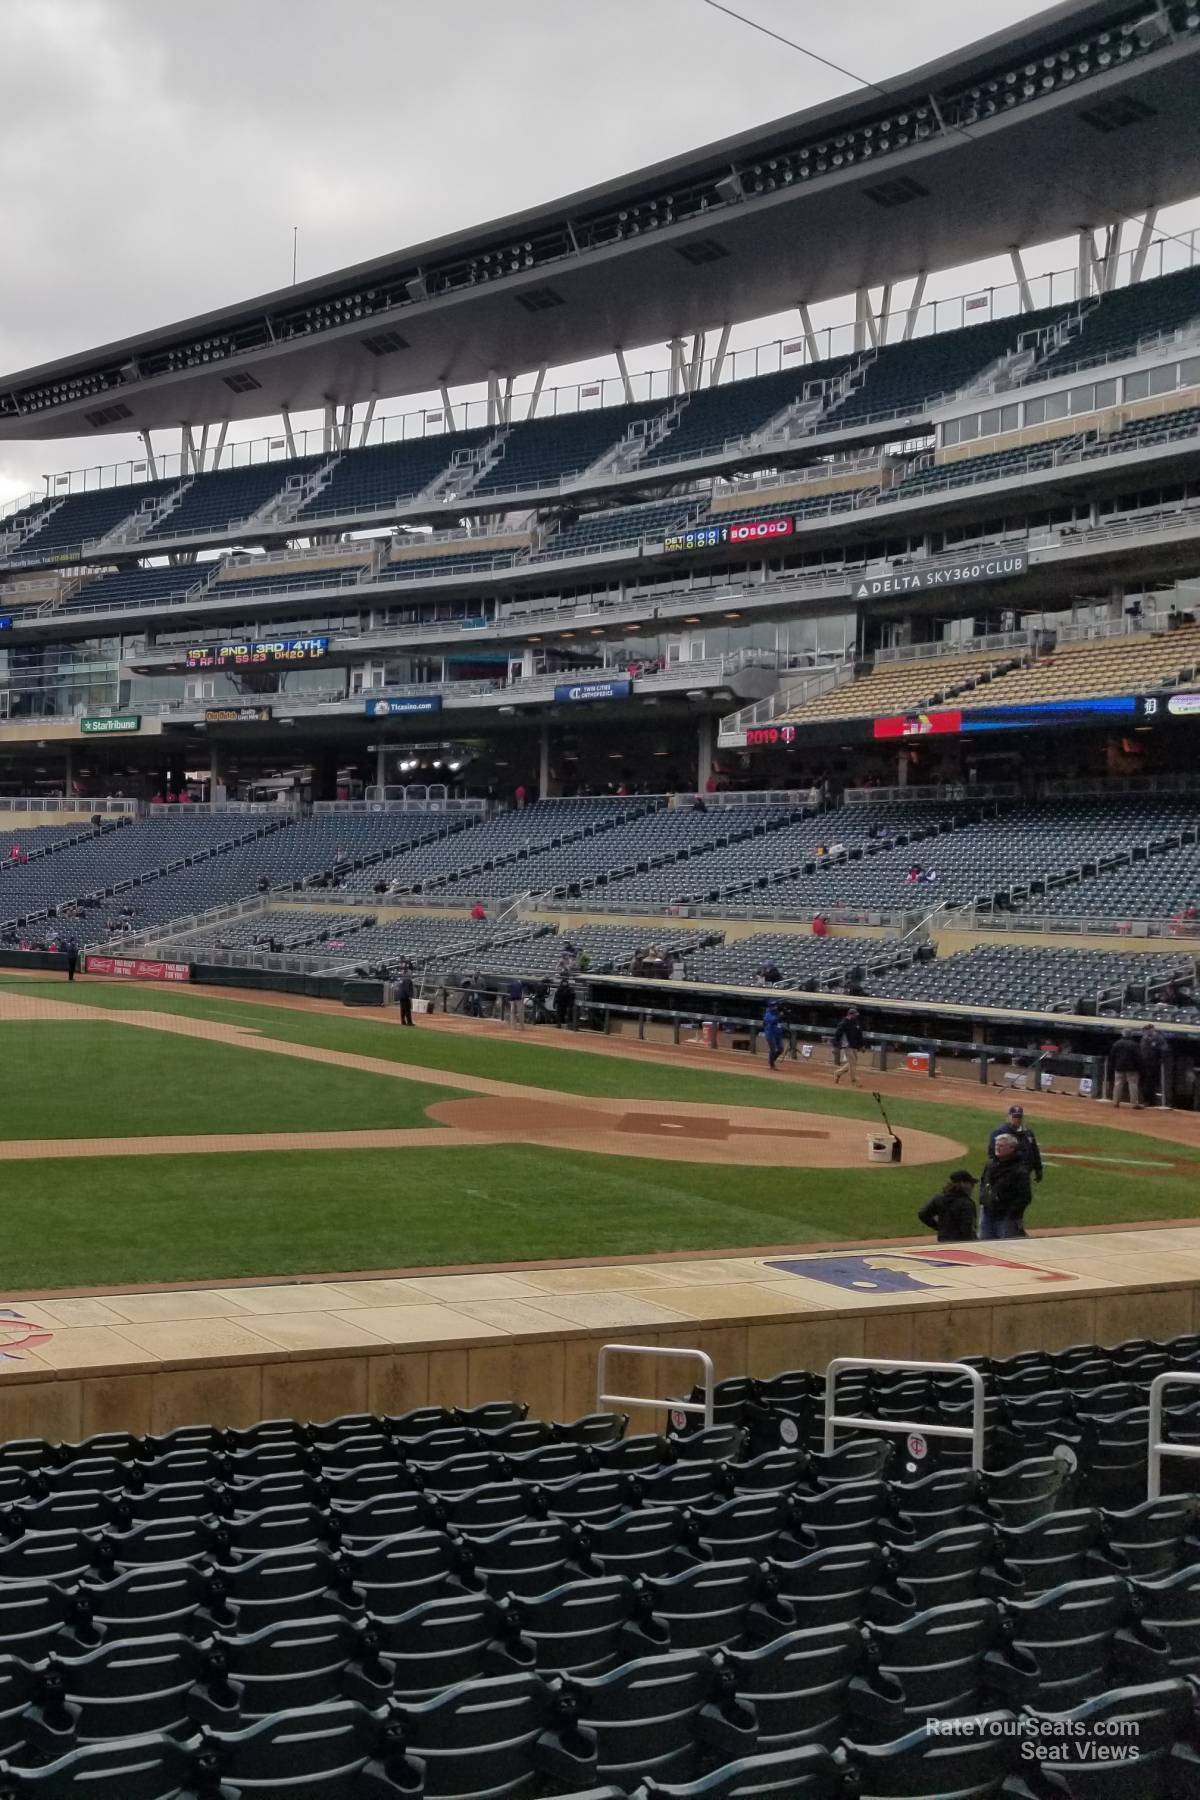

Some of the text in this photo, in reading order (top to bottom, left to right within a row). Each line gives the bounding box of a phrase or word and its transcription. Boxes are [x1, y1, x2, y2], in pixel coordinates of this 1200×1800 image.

[665, 536, 683, 545] DET
[665, 544, 682, 552] MIN
[872, 576, 921, 594] DELTA
[188, 640, 320, 658] 1ST 2ND 3RD 4TH
[253, 653, 266, 662] 23
[275, 651, 289, 660] DH
[290, 650, 304, 659] 20
[310, 649, 323, 657] LF
[581, 690, 613, 698] ORTHOPEDICS
[92, 720, 136, 730] StarTribune
